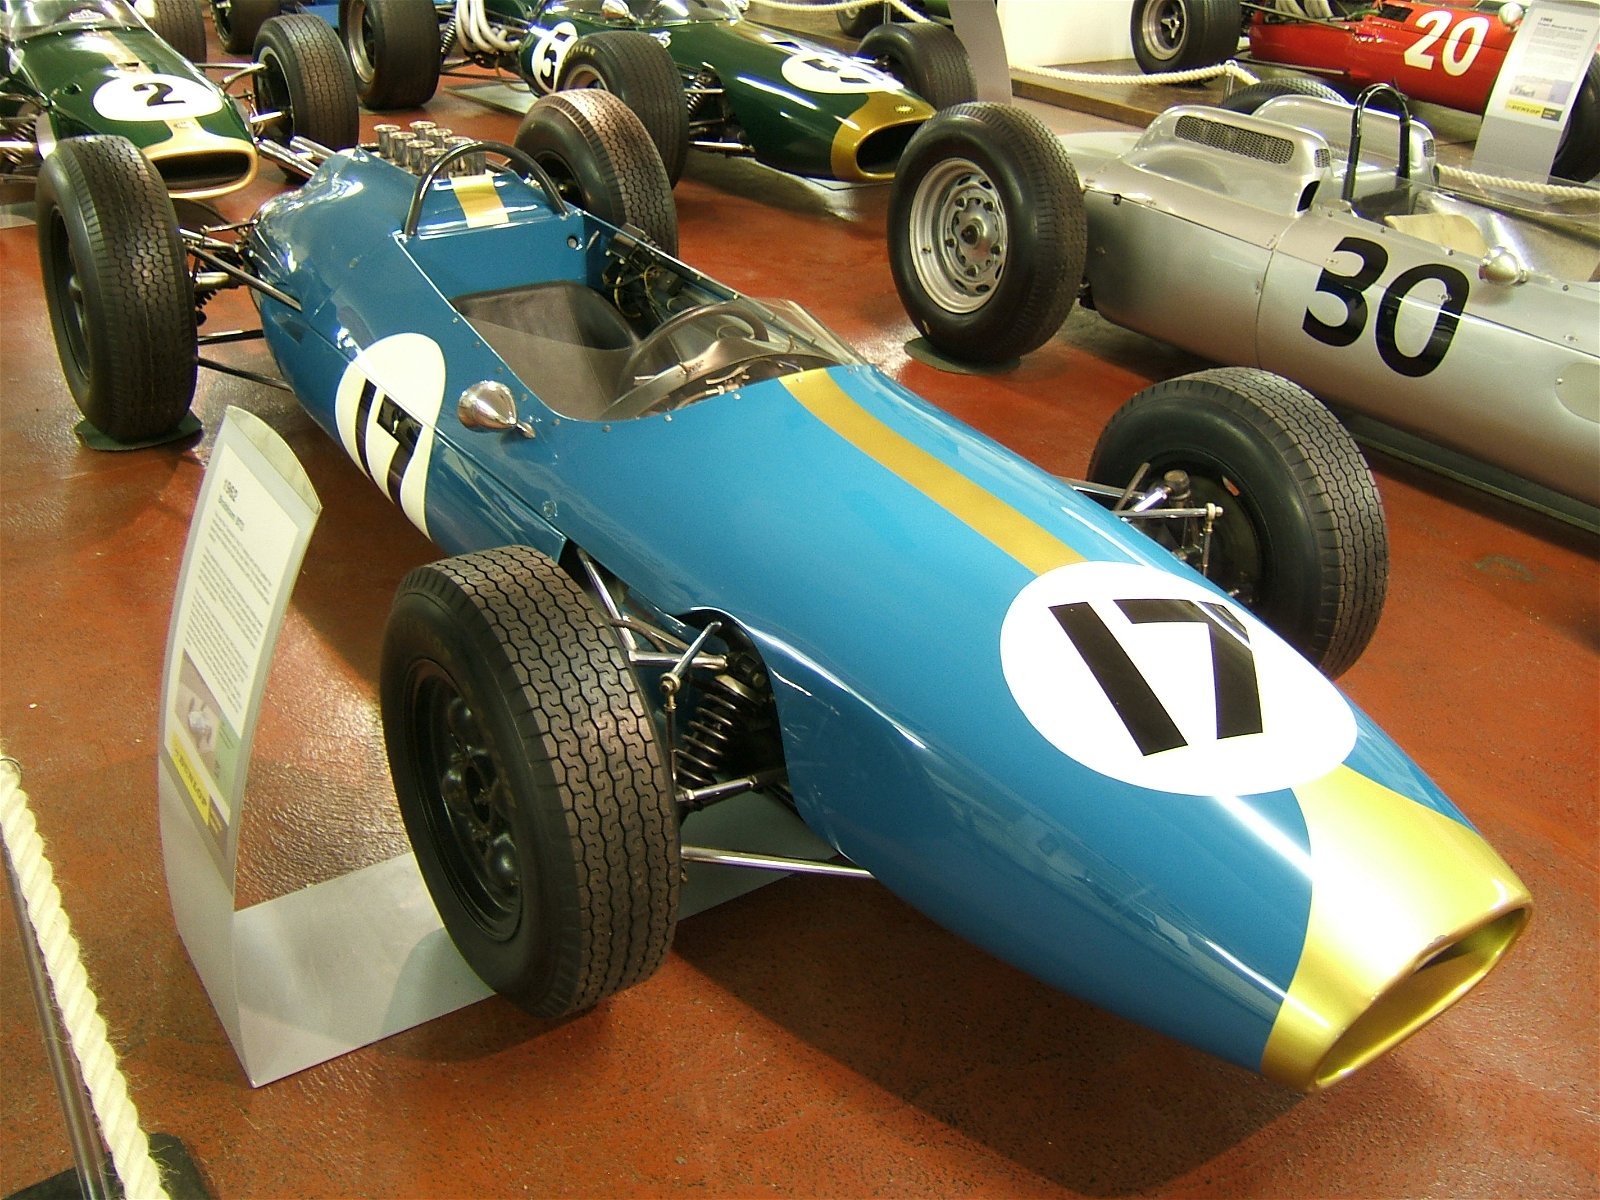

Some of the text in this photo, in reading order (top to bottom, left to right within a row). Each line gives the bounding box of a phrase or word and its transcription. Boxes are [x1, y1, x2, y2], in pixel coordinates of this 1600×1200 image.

[132, 82, 187, 107] 2
[1403, 10, 1490, 77] 20
[1302, 236, 1470, 378] 30
[354, 377, 424, 506] 17
[1047, 598, 1264, 757] 17
